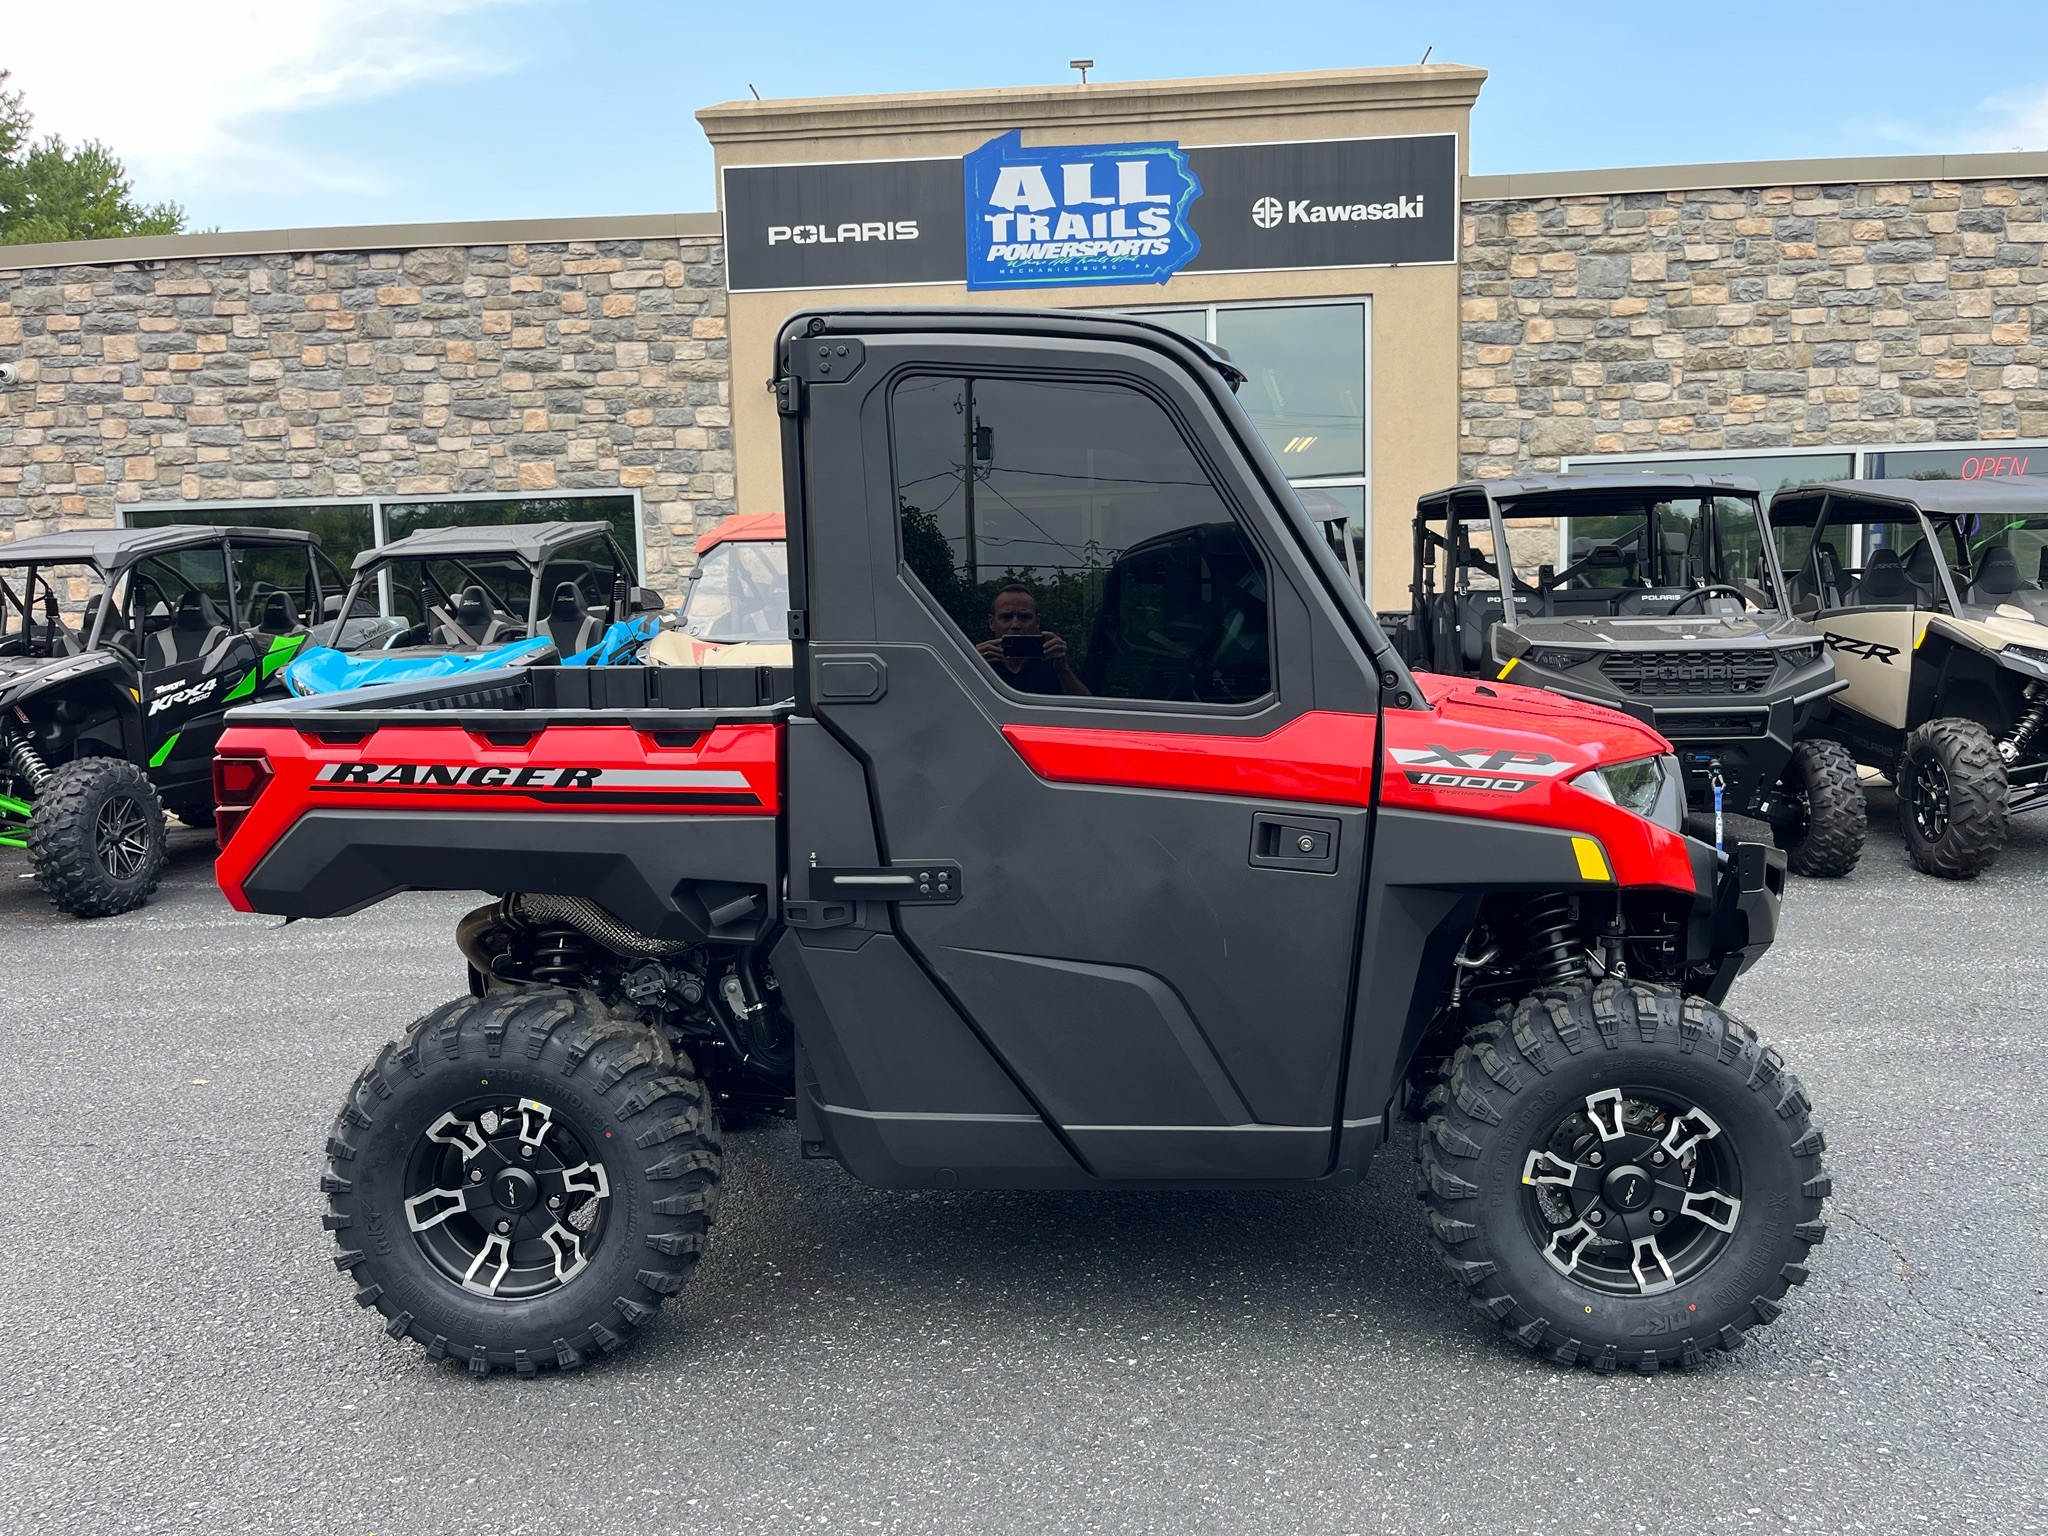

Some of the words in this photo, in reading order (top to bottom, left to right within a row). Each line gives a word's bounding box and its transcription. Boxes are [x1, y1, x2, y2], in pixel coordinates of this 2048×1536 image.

[988, 160, 1171, 212] ALL
[1288, 194, 1424, 223] Kawasaki
[767, 220, 920, 246] POLARIS
[984, 207, 1172, 243] TRAILS
[986, 237, 1171, 262] POWERSPORTS
[1961, 456, 2029, 481] OPEN
[1824, 631, 1902, 666] RZR
[1641, 665, 1749, 680] POLARIS
[188, 691, 212, 705] 1000
[1402, 743, 1557, 771] XP
[1853, 735, 1894, 758] POLARIS
[328, 762, 603, 789] RANGER
[1417, 772, 1525, 792] 1000
[1438, 789, 1491, 797] OVERHEAD
[484, 1068, 525, 1083] PRO
[1498, 1099, 1543, 1171] ARMOR
[1490, 1172, 1507, 1208] PRO
[1711, 1191, 1788, 1310] X-TERRAIN
[394, 1273, 514, 1340] X-TERRAIN
